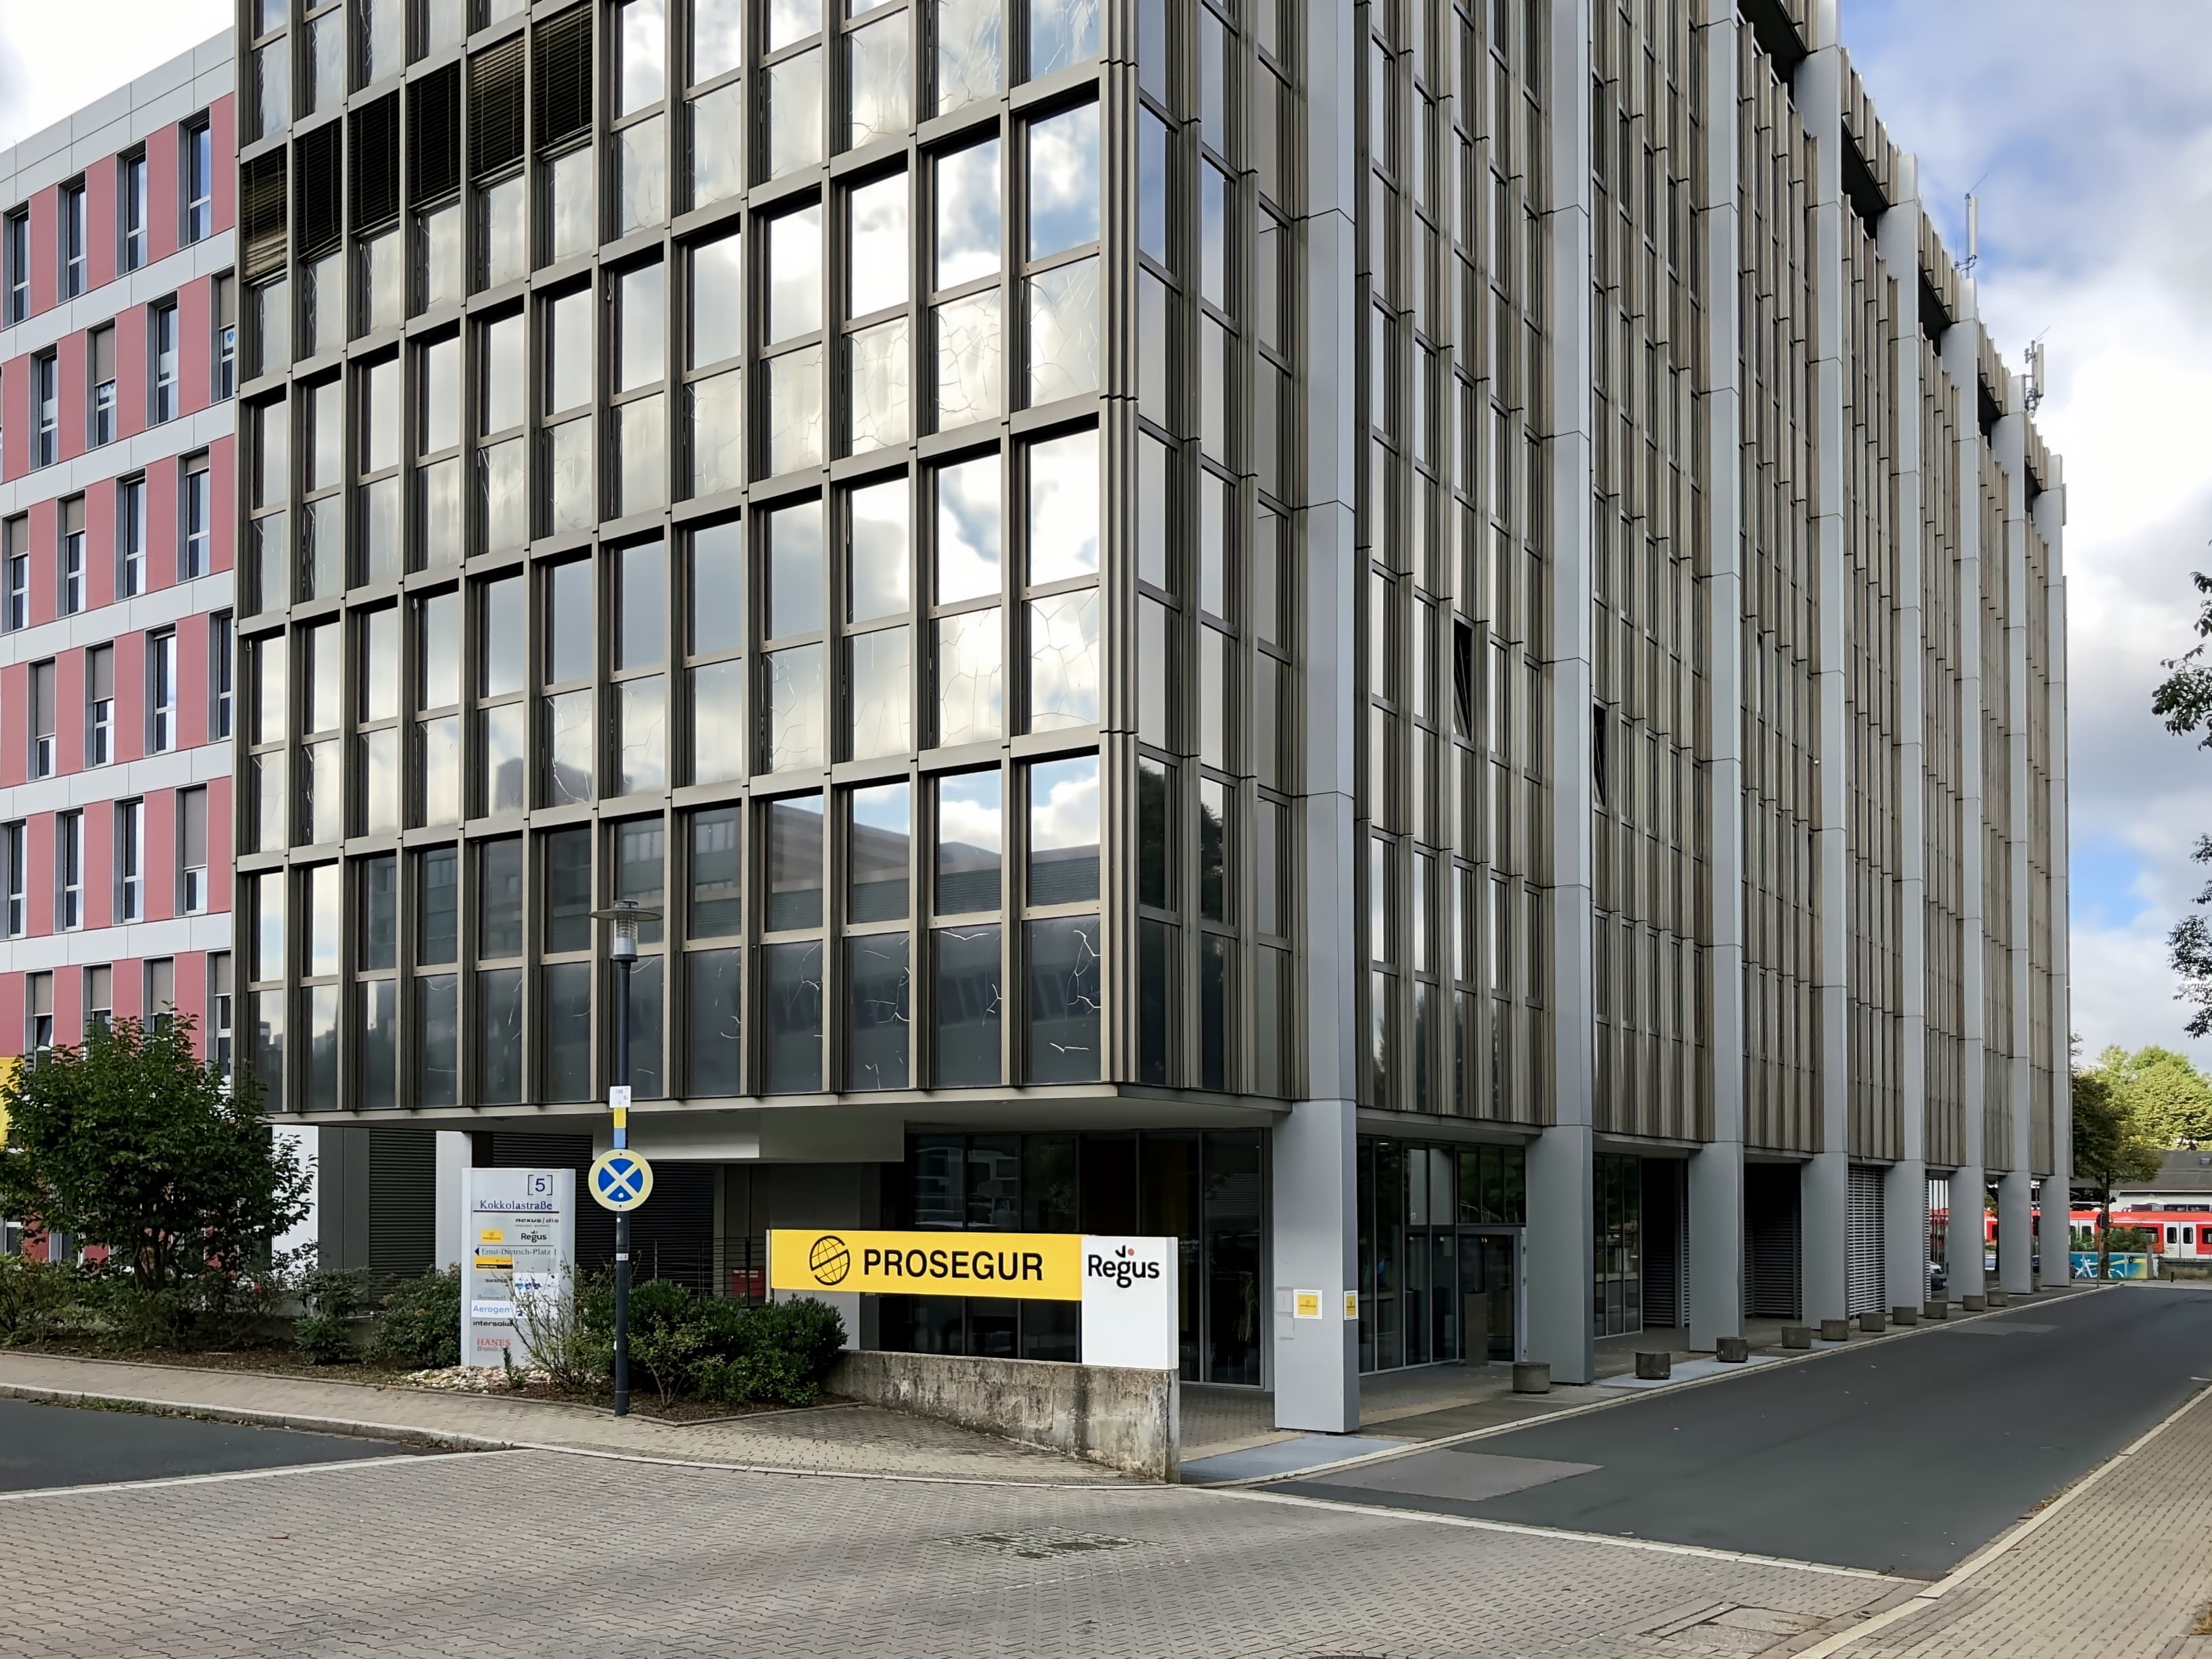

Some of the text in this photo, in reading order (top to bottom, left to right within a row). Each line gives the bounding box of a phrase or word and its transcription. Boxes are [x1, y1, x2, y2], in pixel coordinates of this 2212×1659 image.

[480, 1201, 553, 1210] Kokkolastraße
[521, 1232, 547, 1243] Regus
[864, 1249, 1043, 1281] PROSEGUR
[1088, 1254, 1160, 1289] Regus
[473, 1305, 510, 1314] Aerogen
